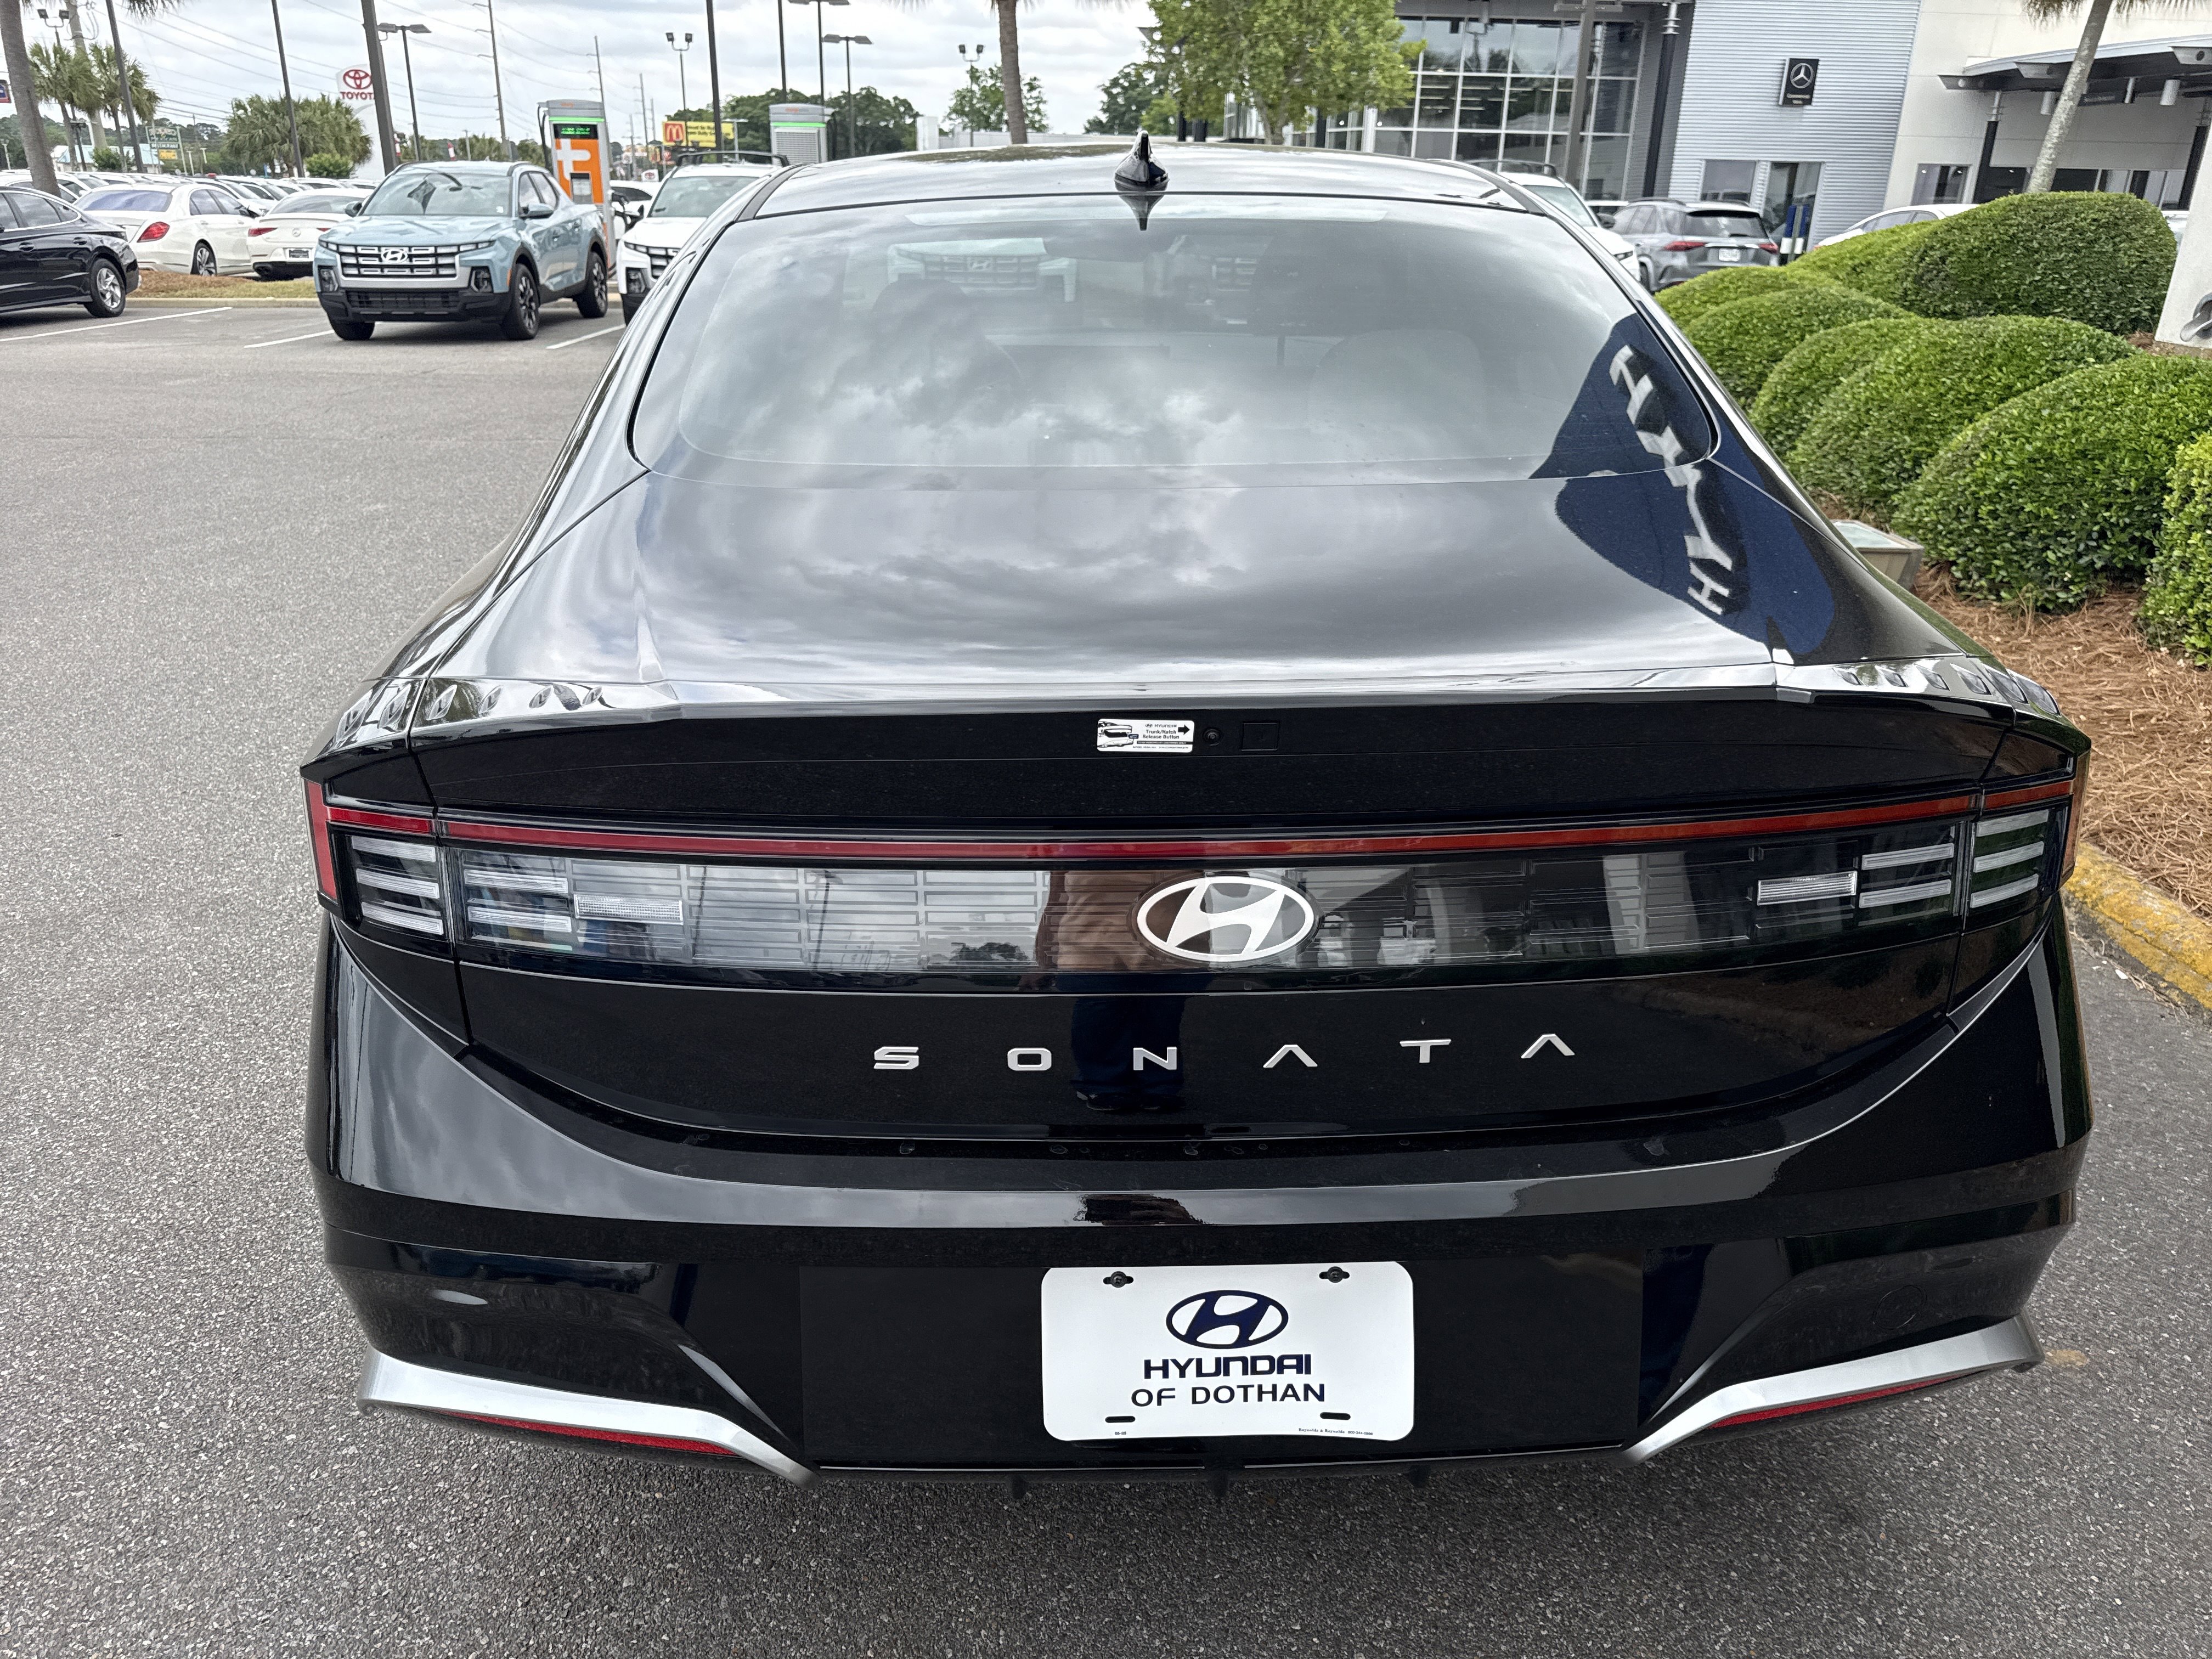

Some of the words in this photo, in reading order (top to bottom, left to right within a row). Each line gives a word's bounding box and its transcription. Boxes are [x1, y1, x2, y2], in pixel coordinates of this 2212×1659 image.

[340, 91, 375, 100] TOYOT
[873, 1034, 1575, 1071] SONATA
[1144, 1353, 1311, 1379] HYUNDAI
[1131, 1387, 1176, 1407] OF
[1191, 1383, 1325, 1404] DOTHAN
